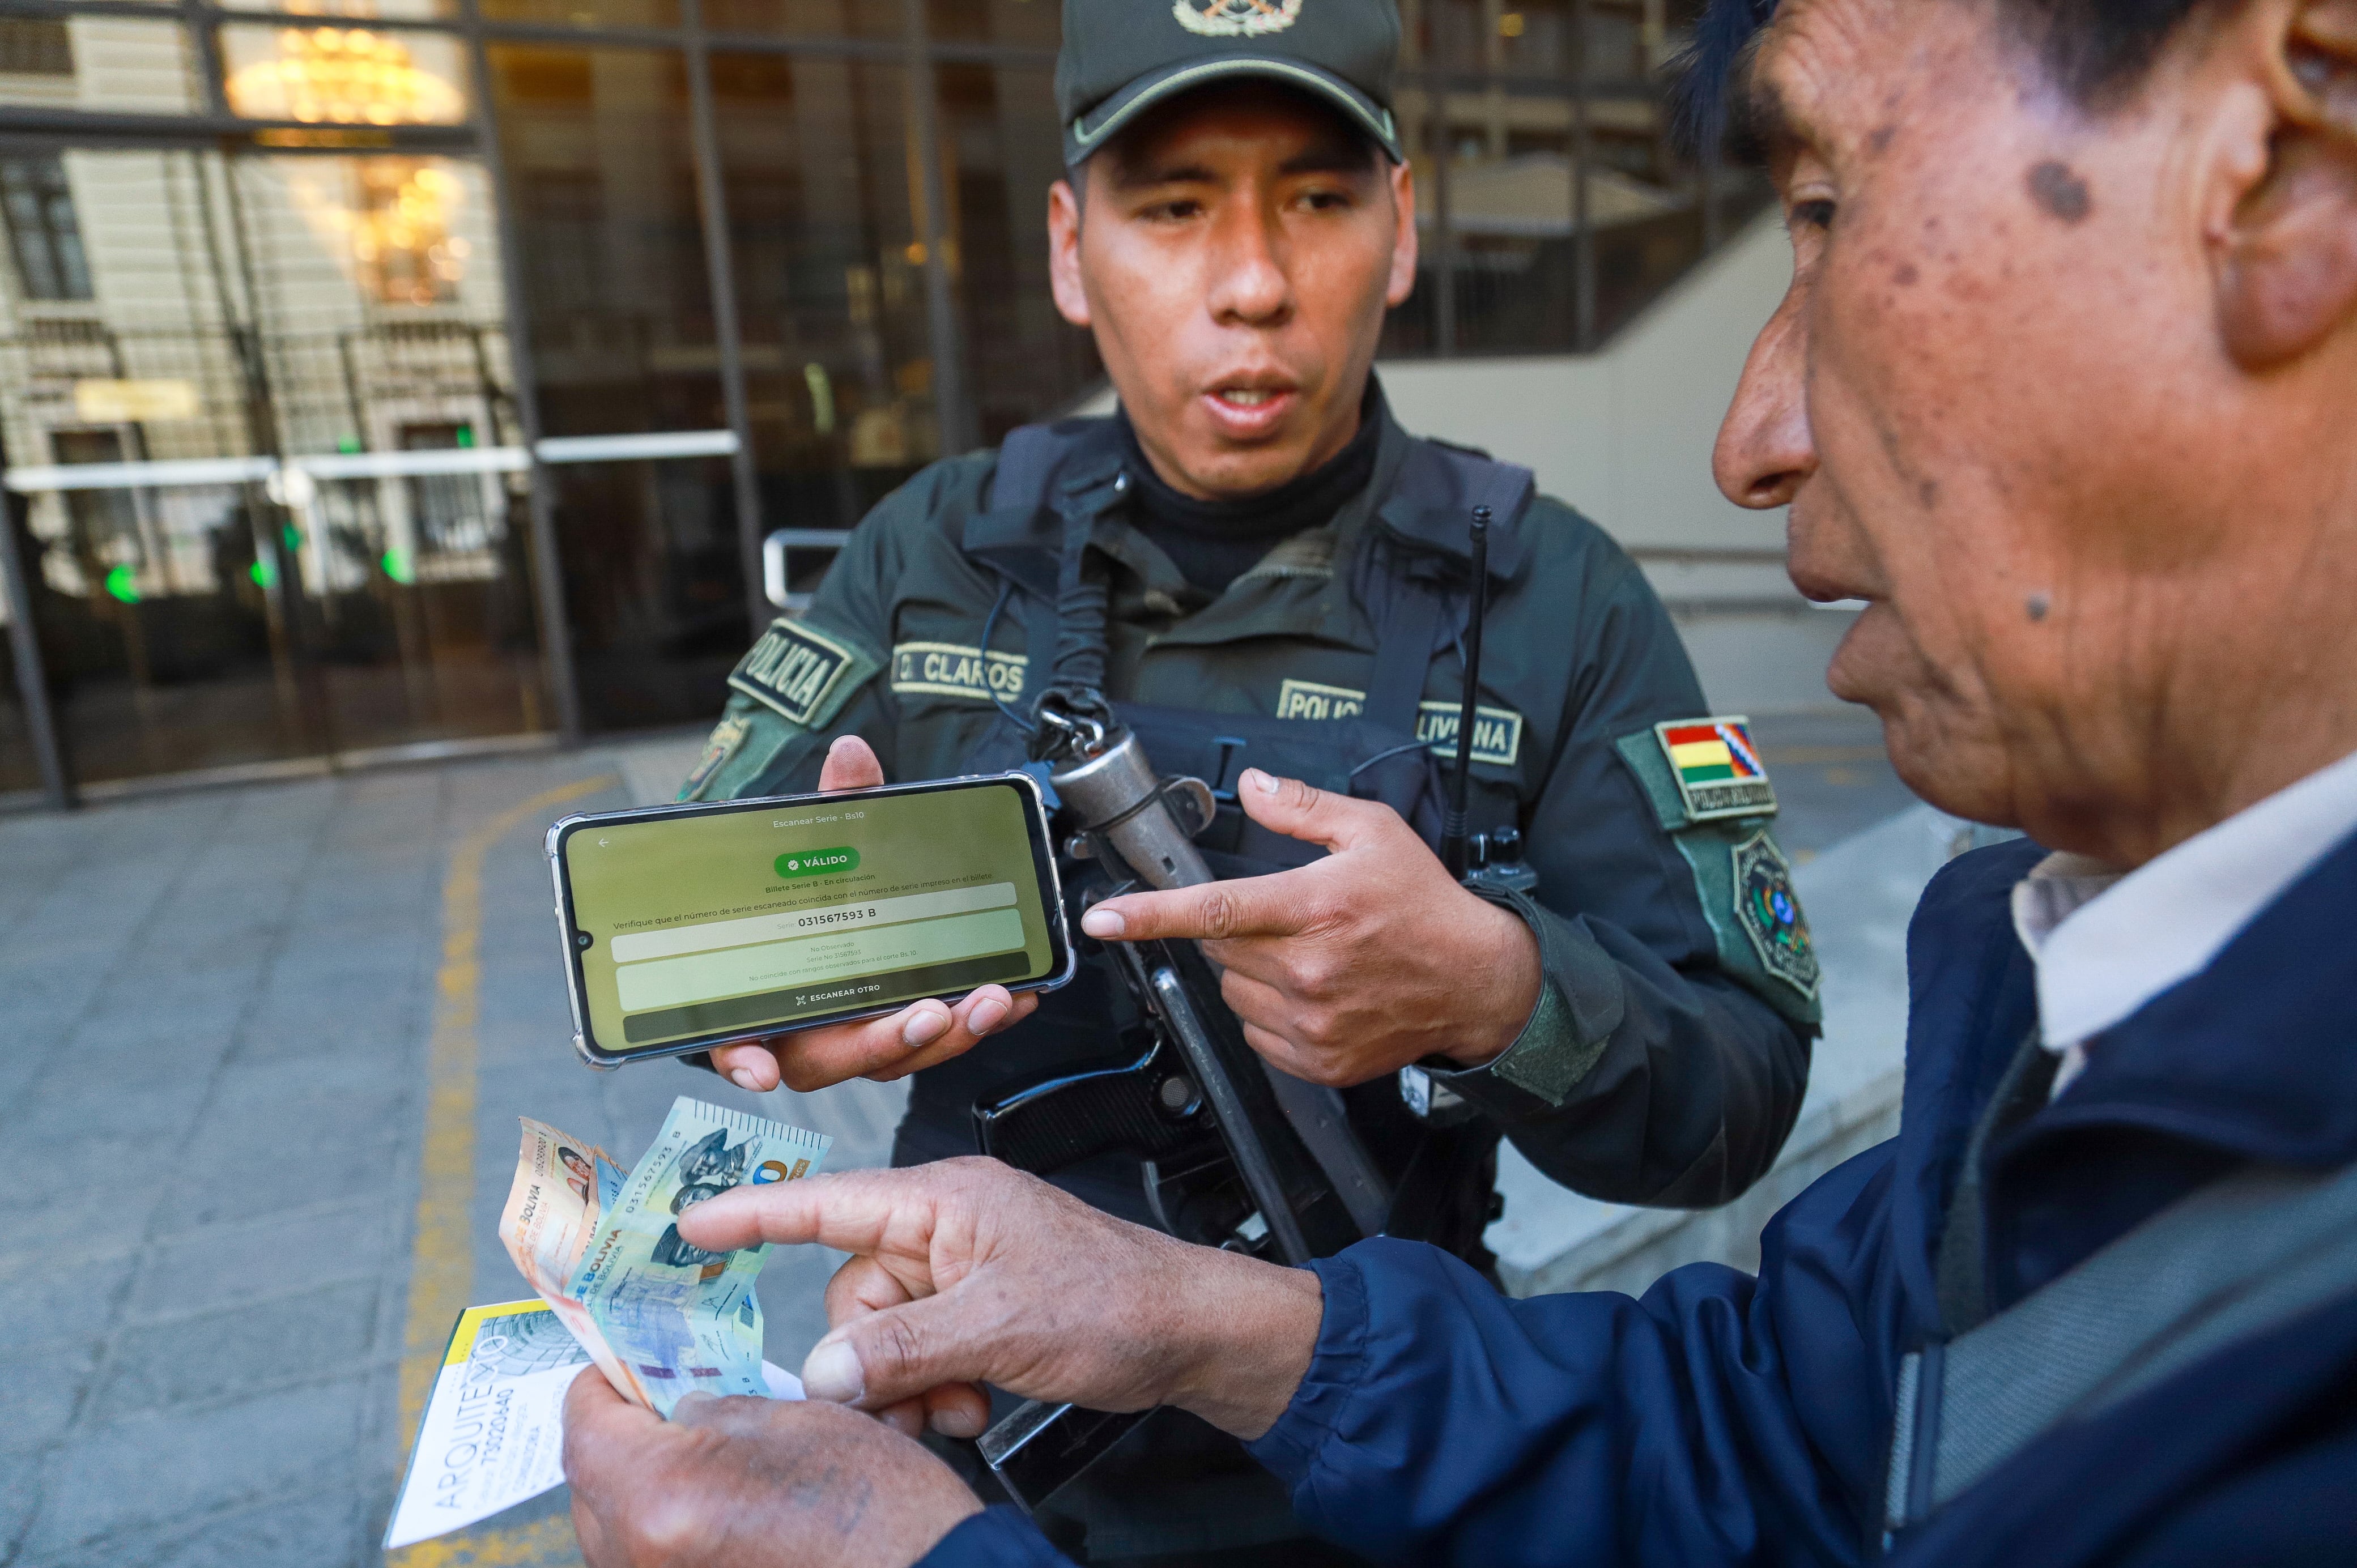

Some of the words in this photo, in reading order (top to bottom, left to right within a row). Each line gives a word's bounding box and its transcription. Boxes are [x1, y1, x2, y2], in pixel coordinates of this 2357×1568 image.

[924, 653, 1024, 693] CLAROS
[773, 819, 813, 828] Escanear
[815, 815, 837, 823] Serie
[845, 811, 865, 820] Bs10
[803, 855, 848, 867] VÁLIDO
[765, 885, 790, 893] Billete
[836, 874, 875, 884] circulación
[613, 919, 653, 930] Verifique
[655, 916, 672, 925] que
[684, 910, 718, 921] número
[732, 905, 752, 914] serie
[754, 899, 797, 910] escaneado
[798, 891, 832, 904] coincida
[858, 886, 888, 897] número
[901, 882, 919, 891] serie
[921, 879, 950, 889] impreso
[798, 909, 863, 927] 031567593
[868, 908, 877, 917] B
[821, 941, 854, 952] Observado
[834, 949, 861, 959] 31567593
[760, 970, 788, 980] coincide
[802, 965, 824, 974] rangos
[825, 960, 860, 970] observados
[862, 957, 875, 965] para
[810, 988, 855, 1002] ESCANEAR
[857, 985, 880, 994] OTRO
[626, 1146, 672, 1213] 031567593
[753, 1160, 787, 1184] 0
[519, 1184, 541, 1226] BOLIVIA
[583, 1229, 622, 1285] BOLIVIA
[597, 1245, 623, 1281] BOLIVIA
[434, 1335, 508, 1509] ARQUITECTO
